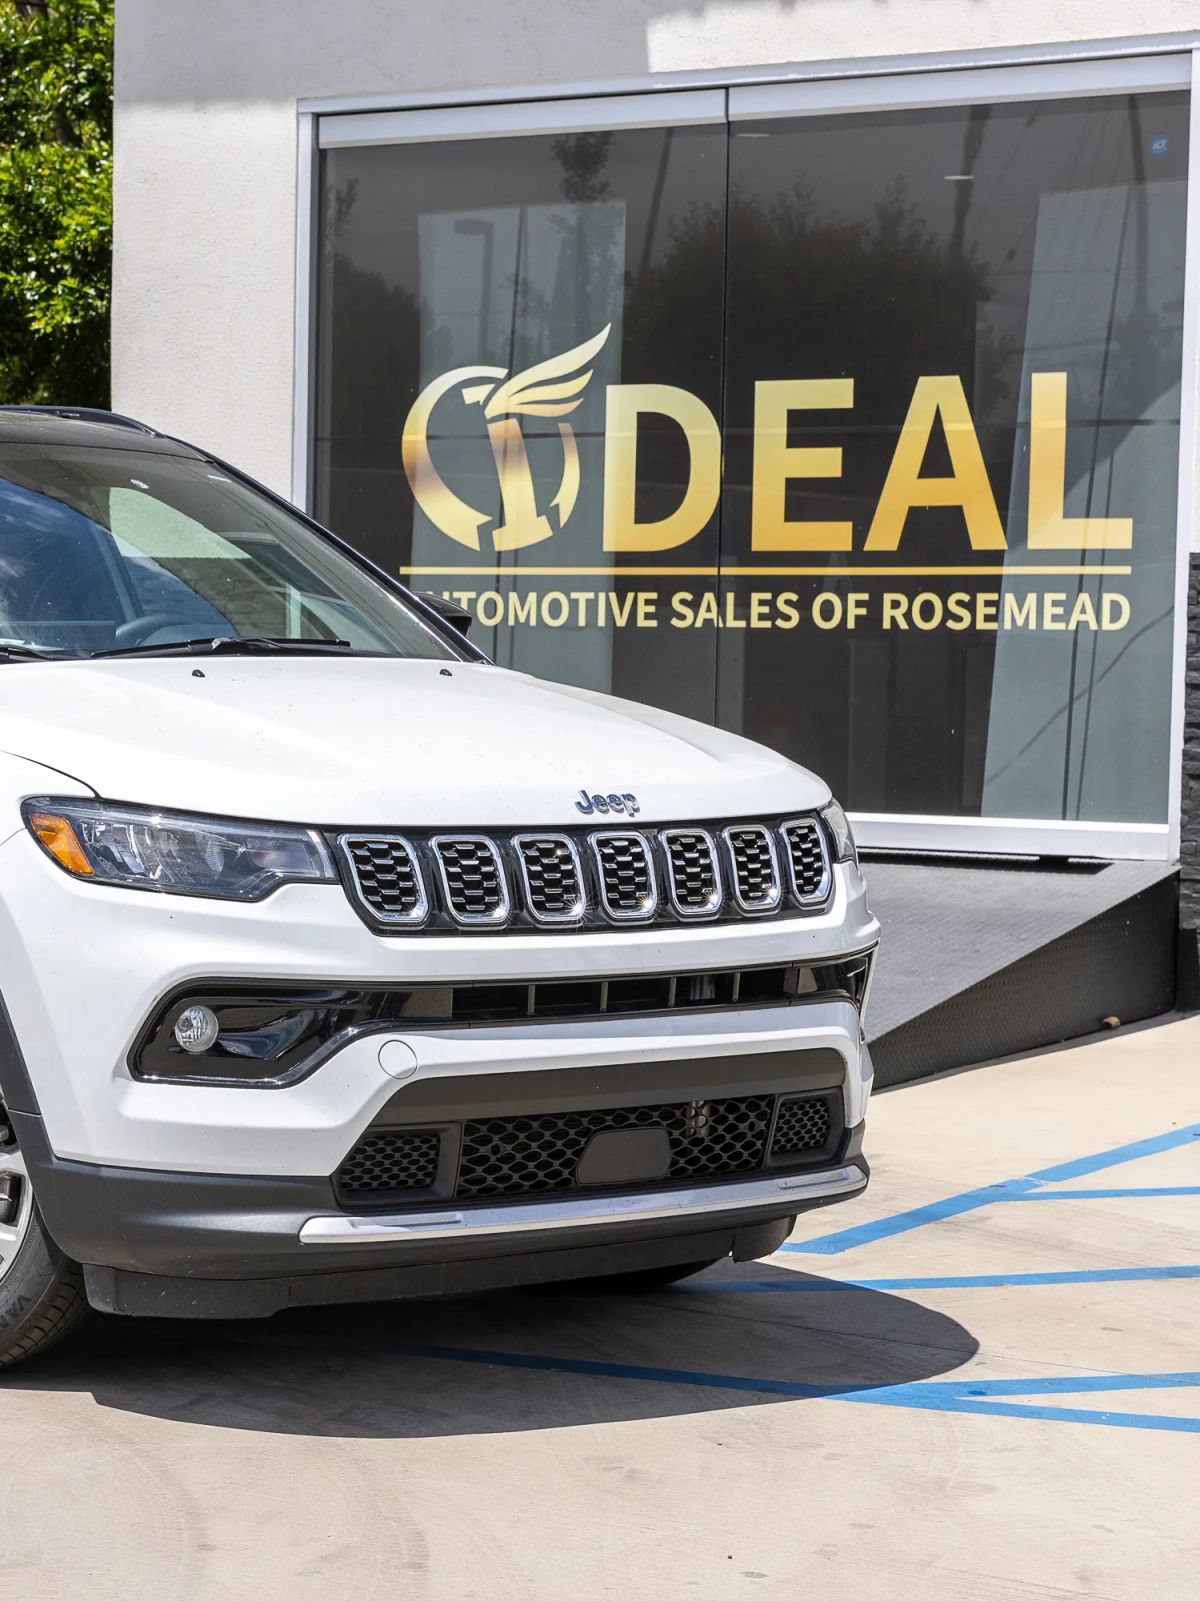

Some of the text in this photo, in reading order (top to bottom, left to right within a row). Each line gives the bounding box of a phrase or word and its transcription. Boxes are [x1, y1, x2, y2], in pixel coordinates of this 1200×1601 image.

[669, 591, 800, 629] SALES
[812, 591, 868, 631] OF
[881, 590, 1132, 632] ROSEMEAD
[575, 789, 640, 817] Jeep
